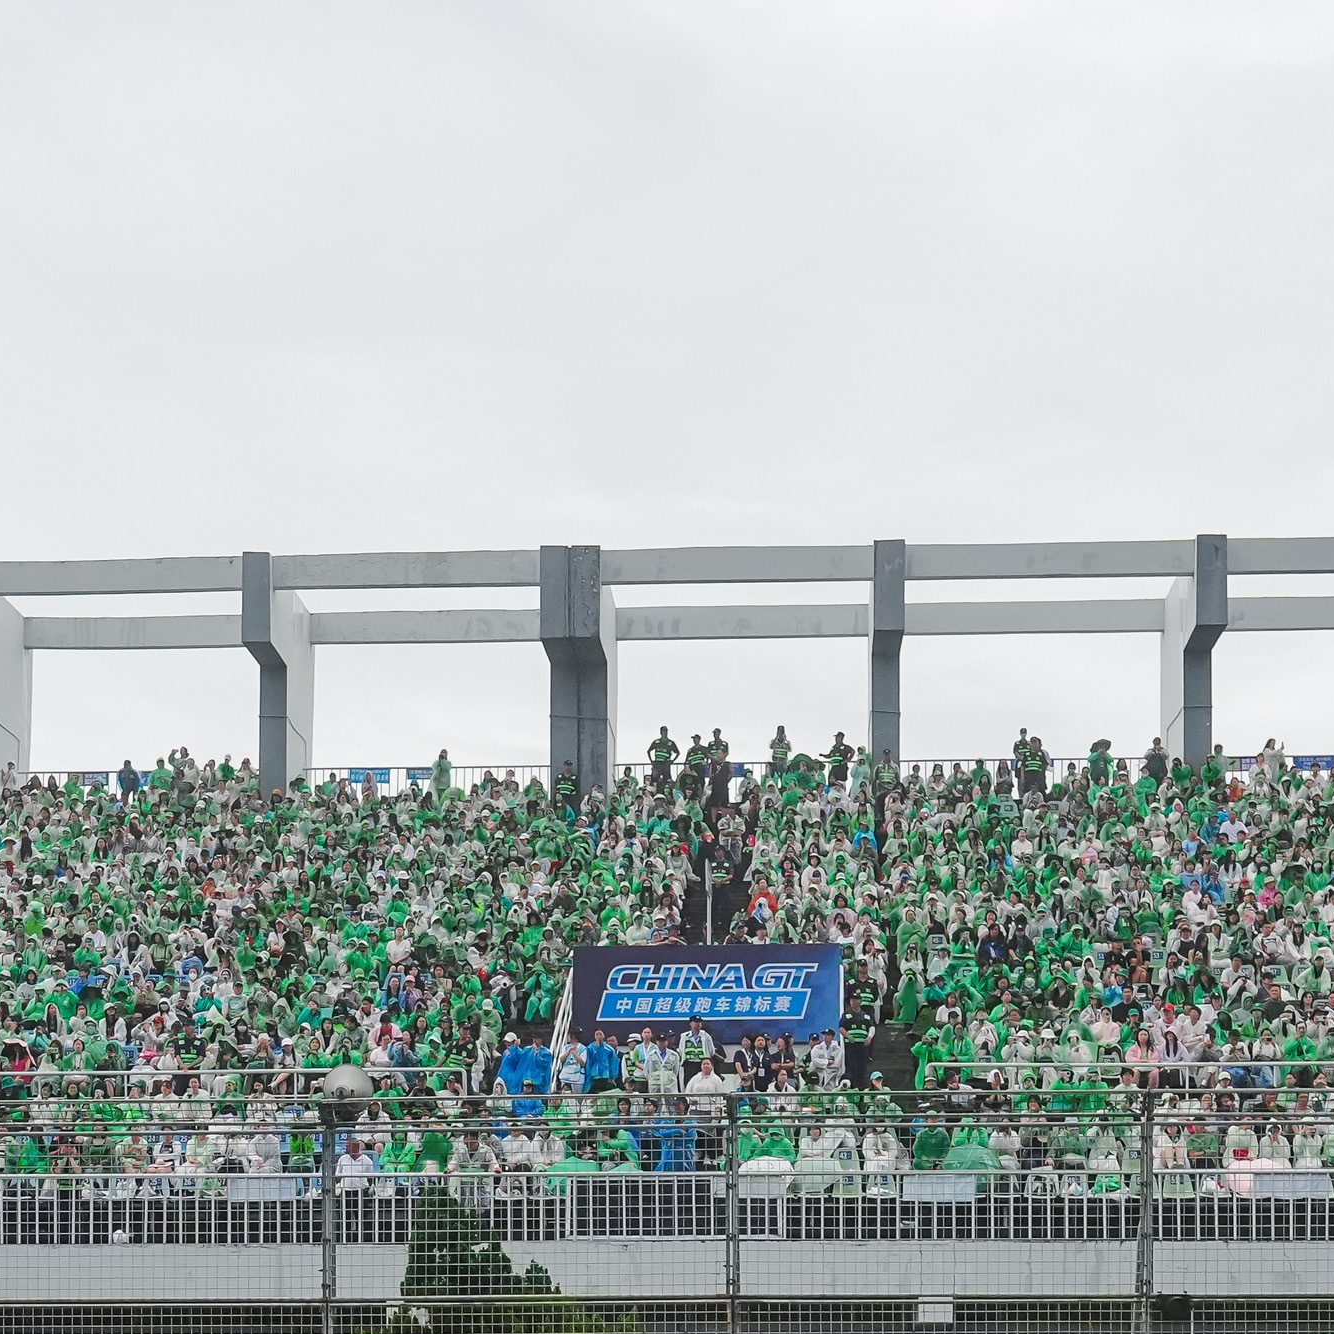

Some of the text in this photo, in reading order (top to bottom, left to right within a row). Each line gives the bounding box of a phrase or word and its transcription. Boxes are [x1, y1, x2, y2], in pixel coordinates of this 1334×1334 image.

[606, 962, 818, 991] CHINA GT
[615, 996, 793, 1014] 中国超级跑车锦标赛
